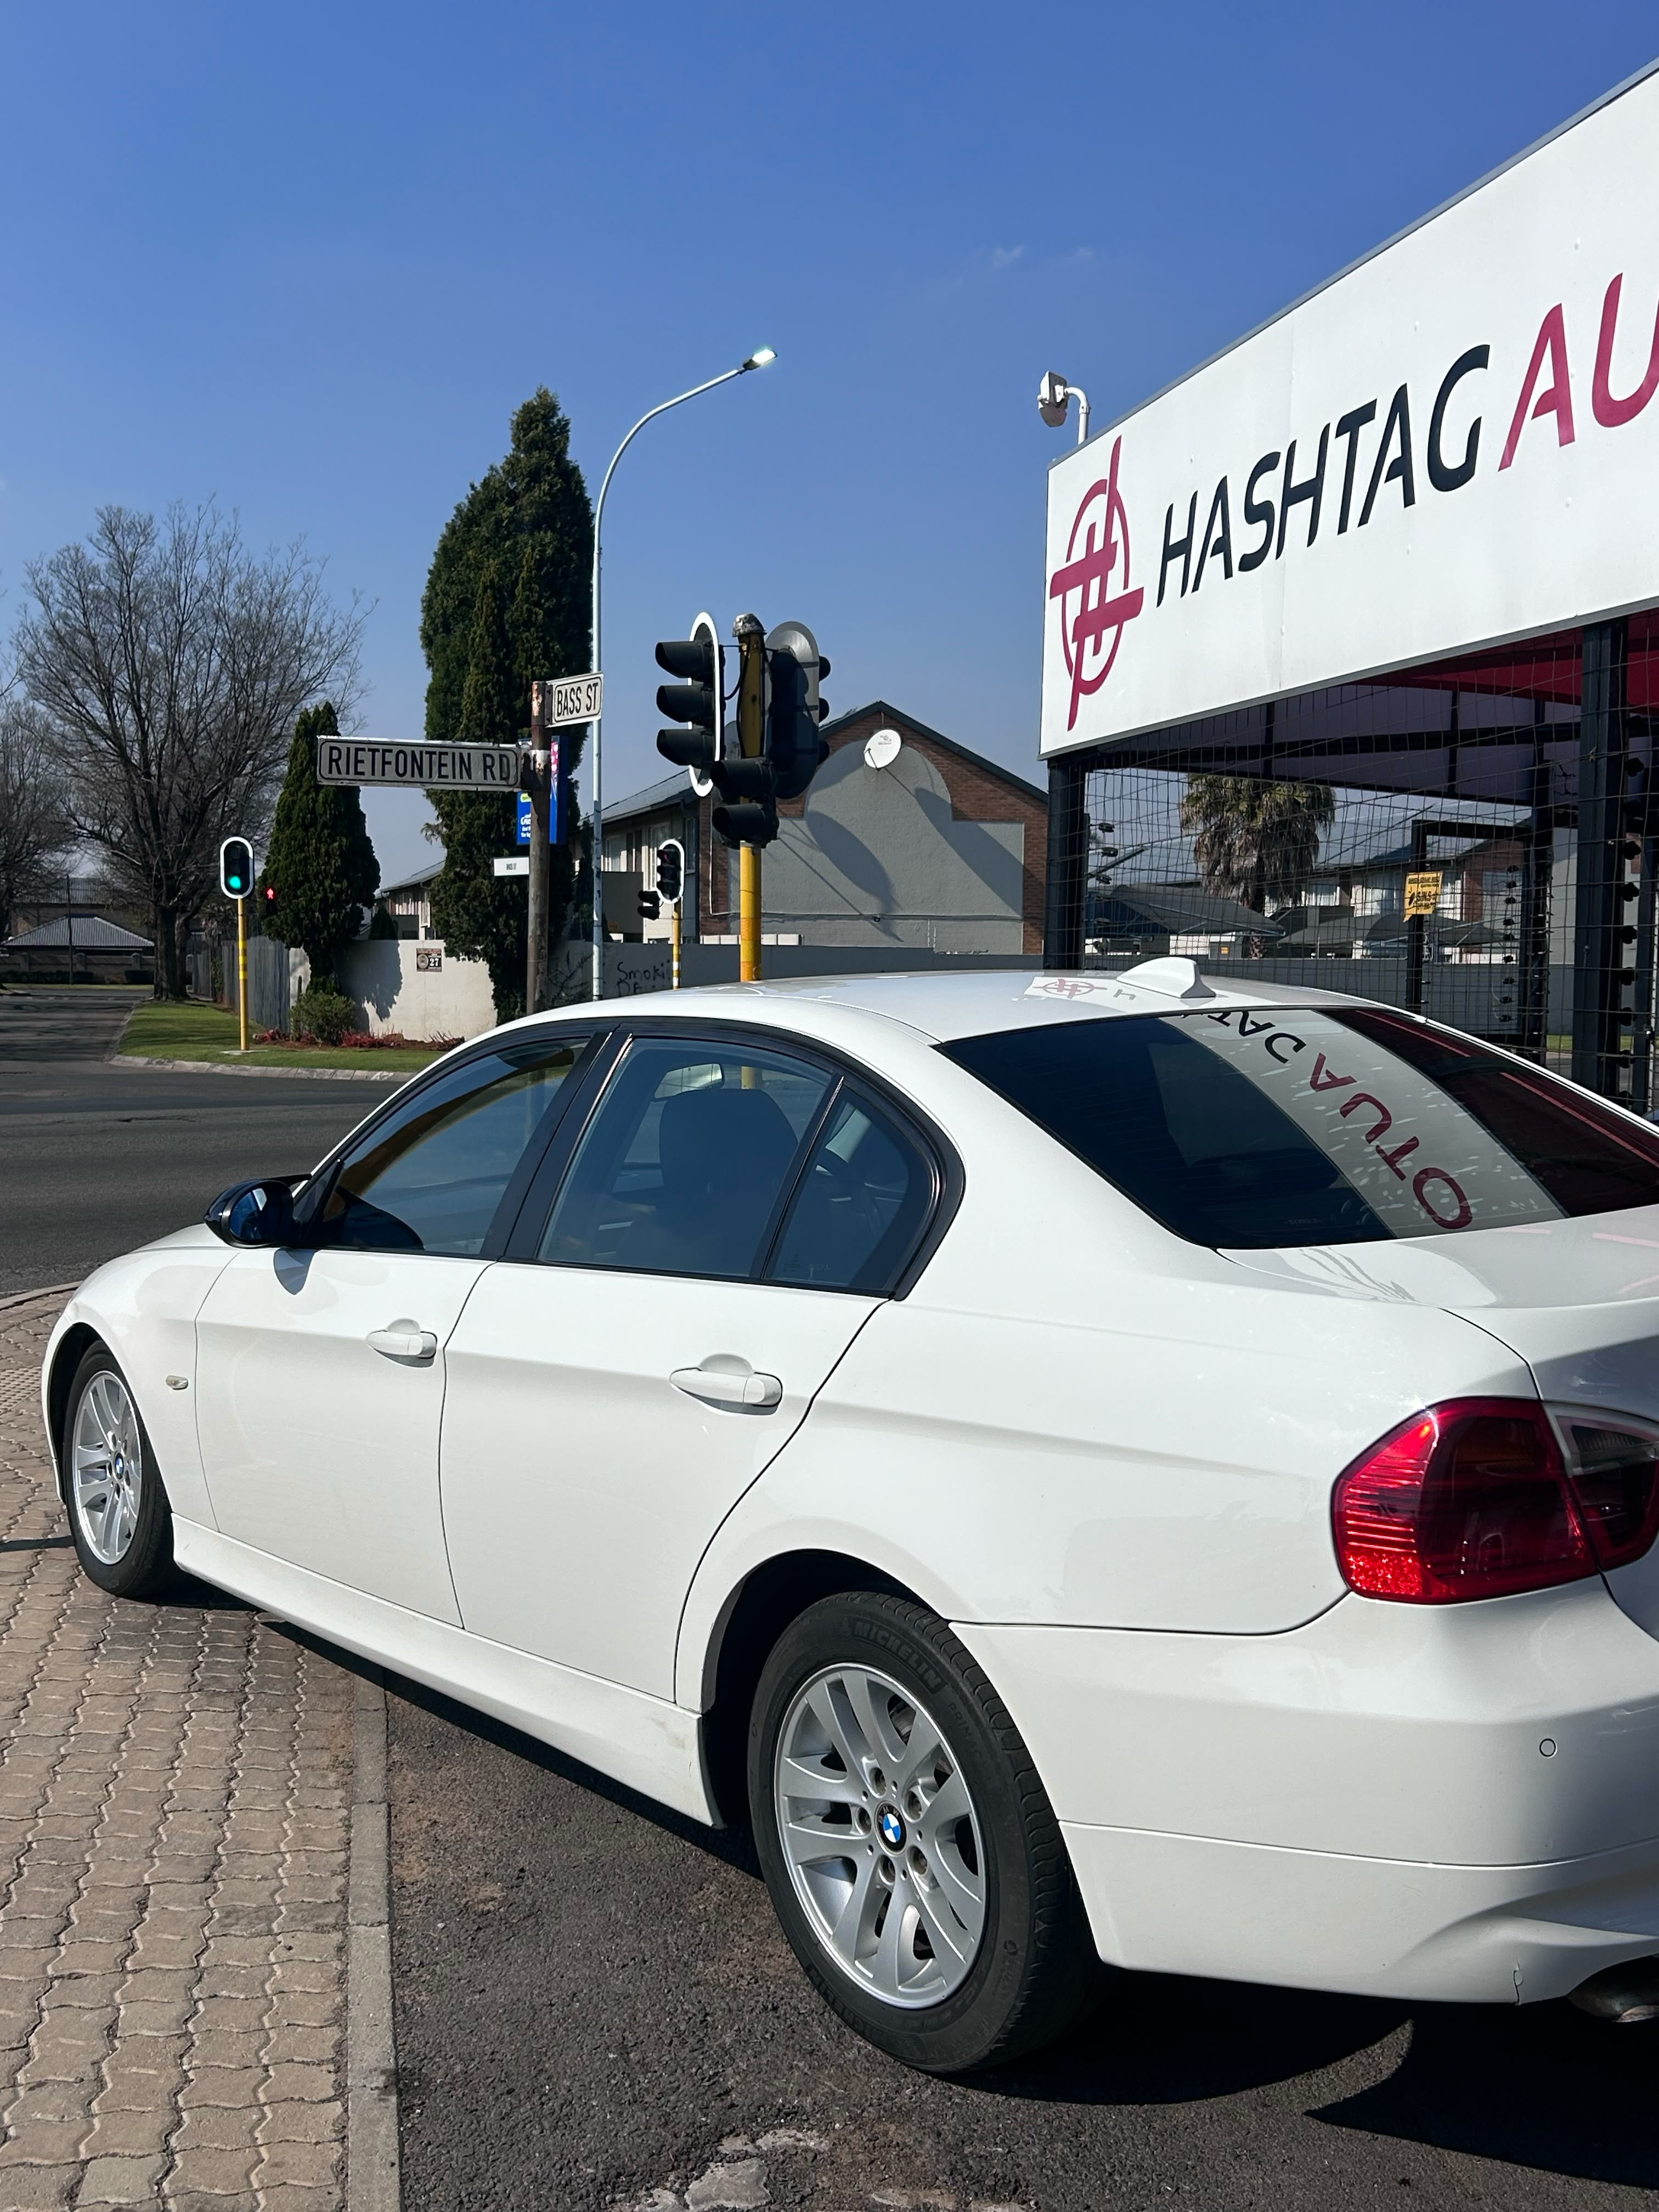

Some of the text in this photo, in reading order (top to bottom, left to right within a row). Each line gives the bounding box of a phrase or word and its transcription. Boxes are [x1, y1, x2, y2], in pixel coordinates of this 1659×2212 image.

[1156, 345, 1490, 607] HASHTAG
[556, 682, 599, 717] BASS ST
[328, 746, 511, 782] RIETFONTEIN RD
[429, 958, 439, 967] 27
[854, 1620, 943, 1689] MICHELIN
